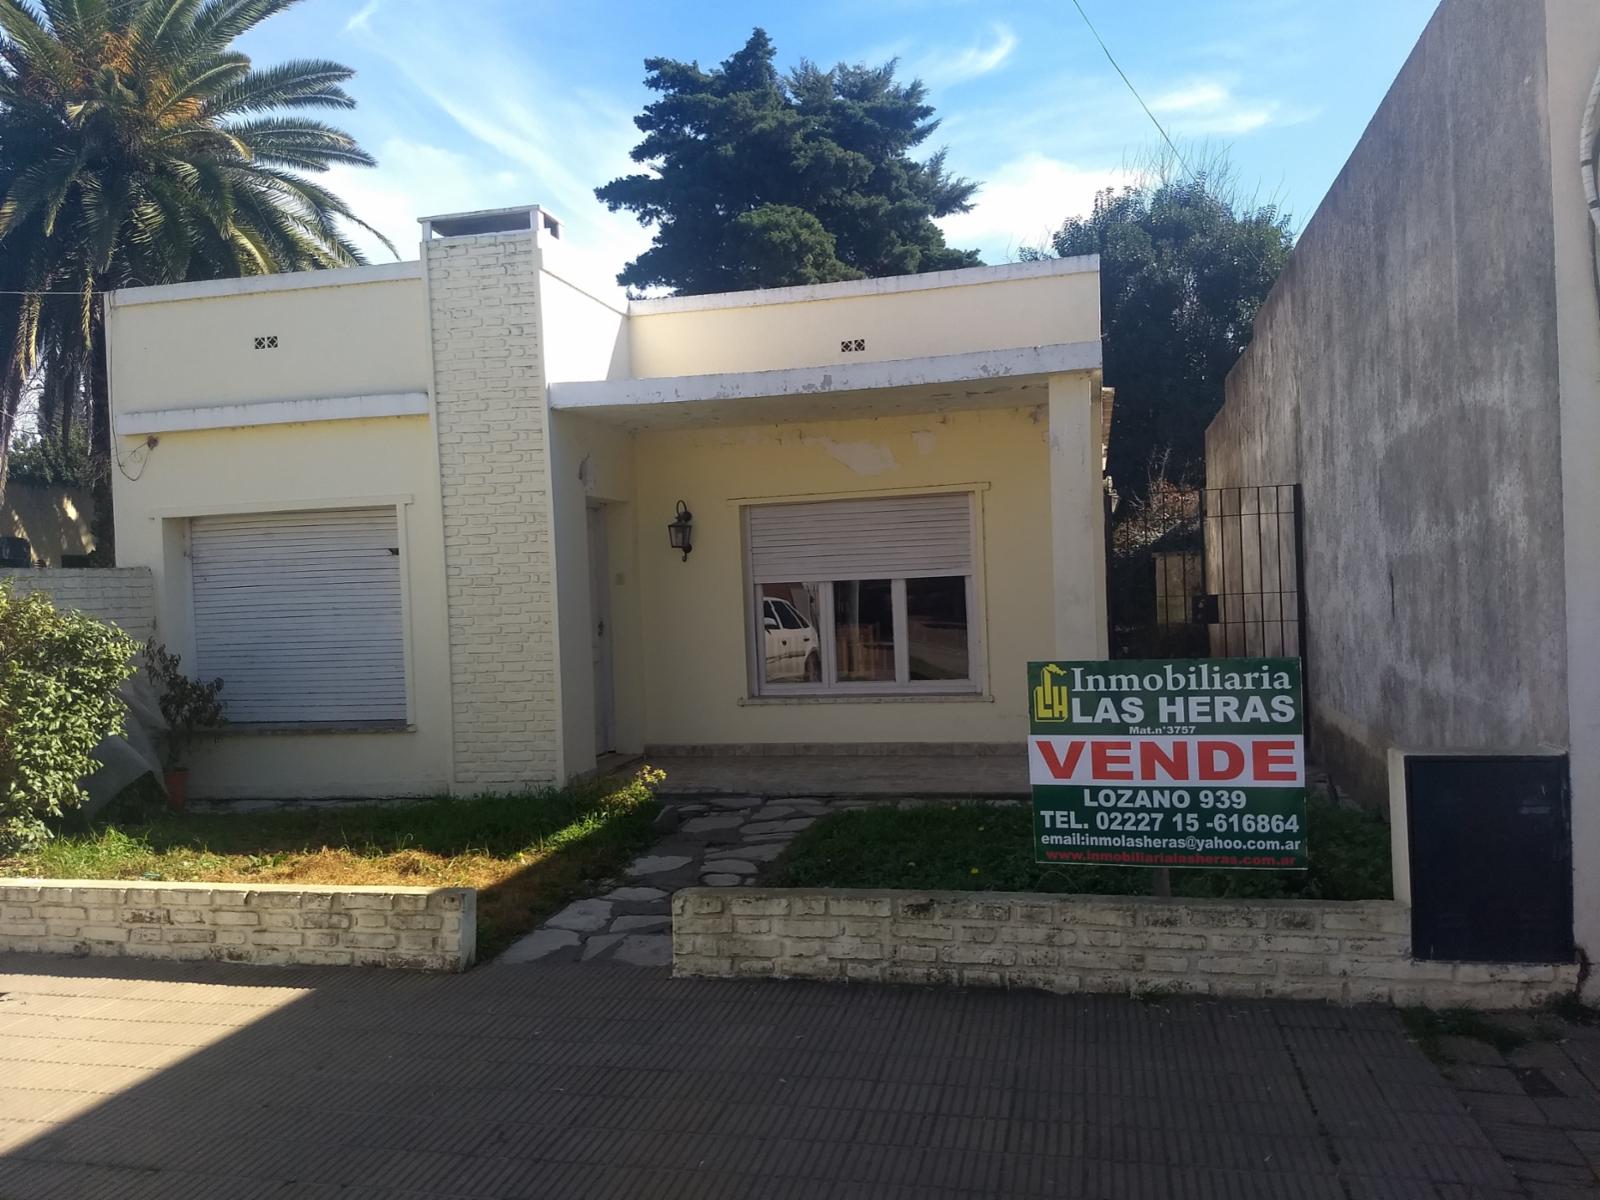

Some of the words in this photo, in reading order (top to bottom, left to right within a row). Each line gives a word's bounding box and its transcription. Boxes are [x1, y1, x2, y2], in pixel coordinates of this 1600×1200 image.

[1071, 664, 1292, 692] Inmobiliaria
[1072, 697, 1145, 723] LAS
[1158, 695, 1296, 723] HERAS
[1036, 740, 1297, 781] VENDE
[1084, 788, 1191, 809] LOZANO
[1199, 790, 1247, 809] 939
[1040, 810, 1089, 829] TEL.
[1096, 812, 1164, 831] 02227
[1172, 813, 1200, 832] 15
[1206, 813, 1300, 833] -616864
[1041, 833, 1301, 851] email:inmolasheras@yahoo.com.ar
